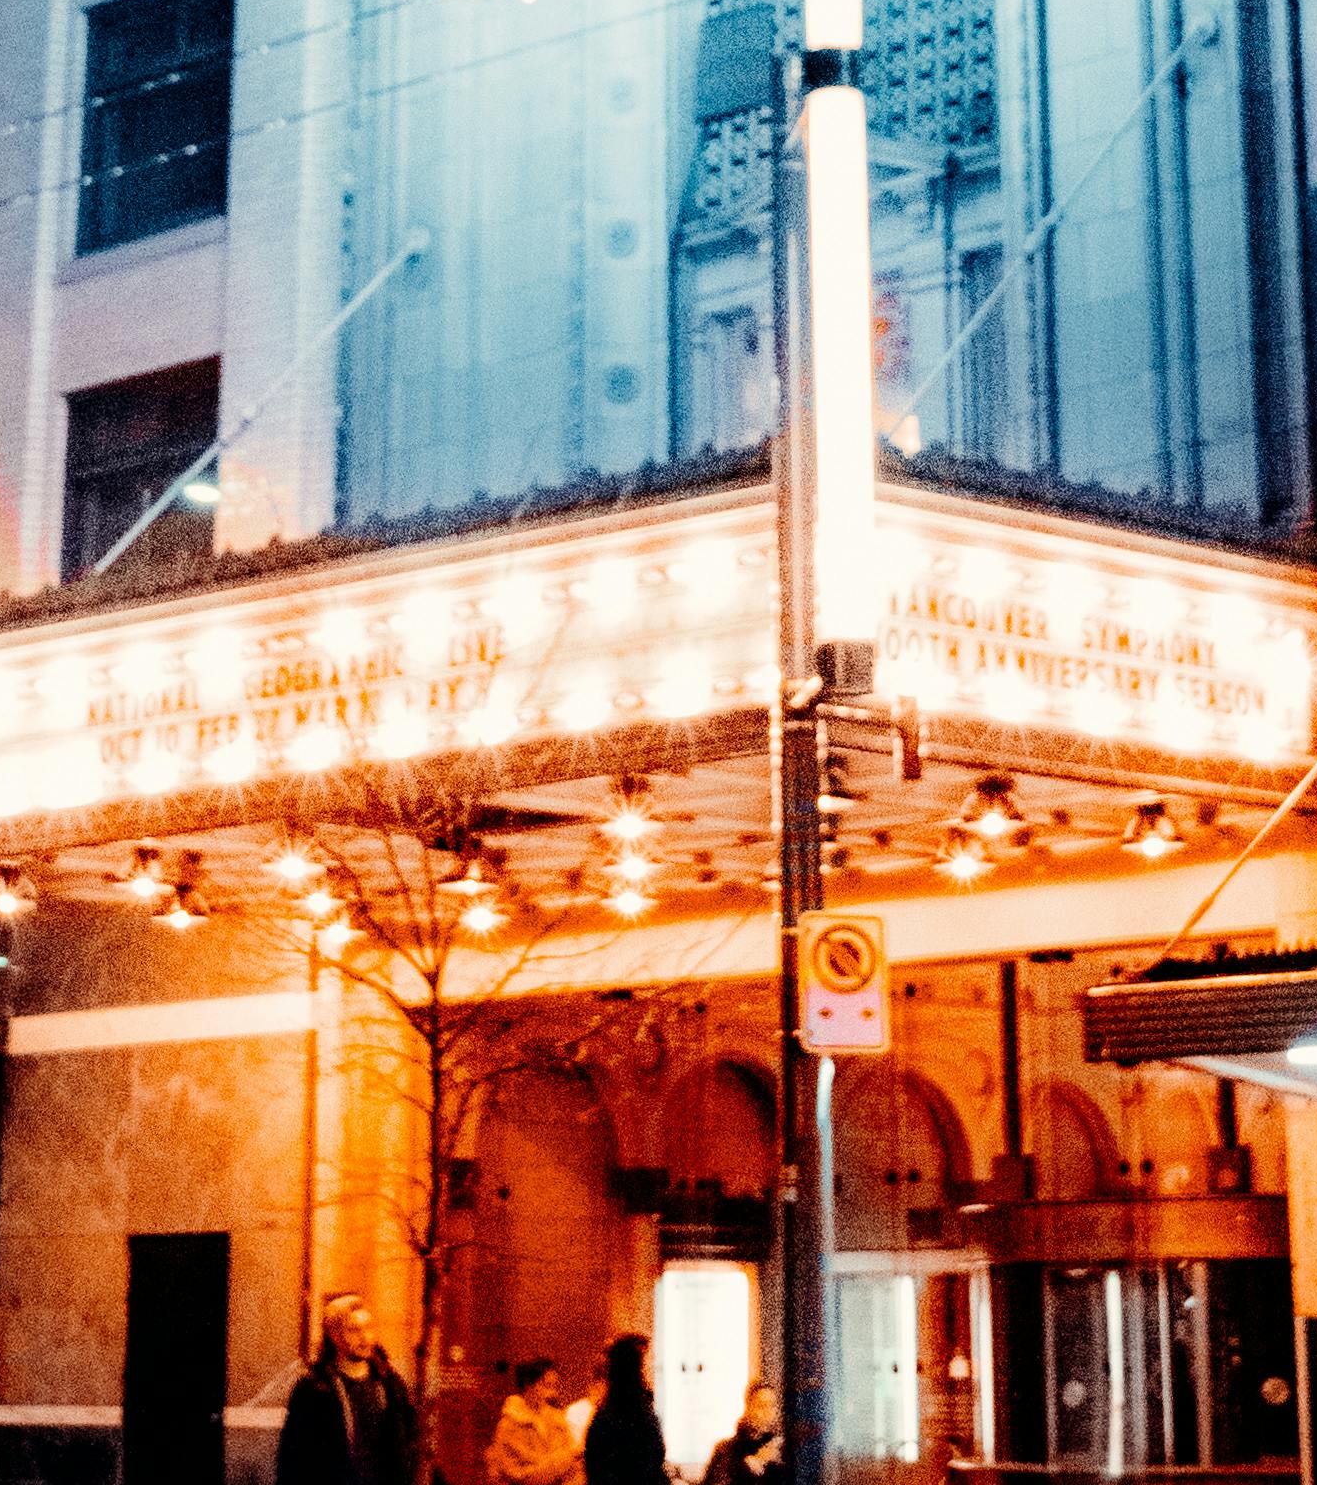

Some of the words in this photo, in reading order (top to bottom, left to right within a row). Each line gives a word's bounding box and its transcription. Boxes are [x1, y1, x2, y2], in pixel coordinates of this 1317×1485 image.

[1082, 613, 1218, 671] SYMPHONY
[85, 675, 200, 727] NATIONAL
[243, 641, 404, 702] GEOGRAPHIC
[100, 727, 143, 765] OCT
